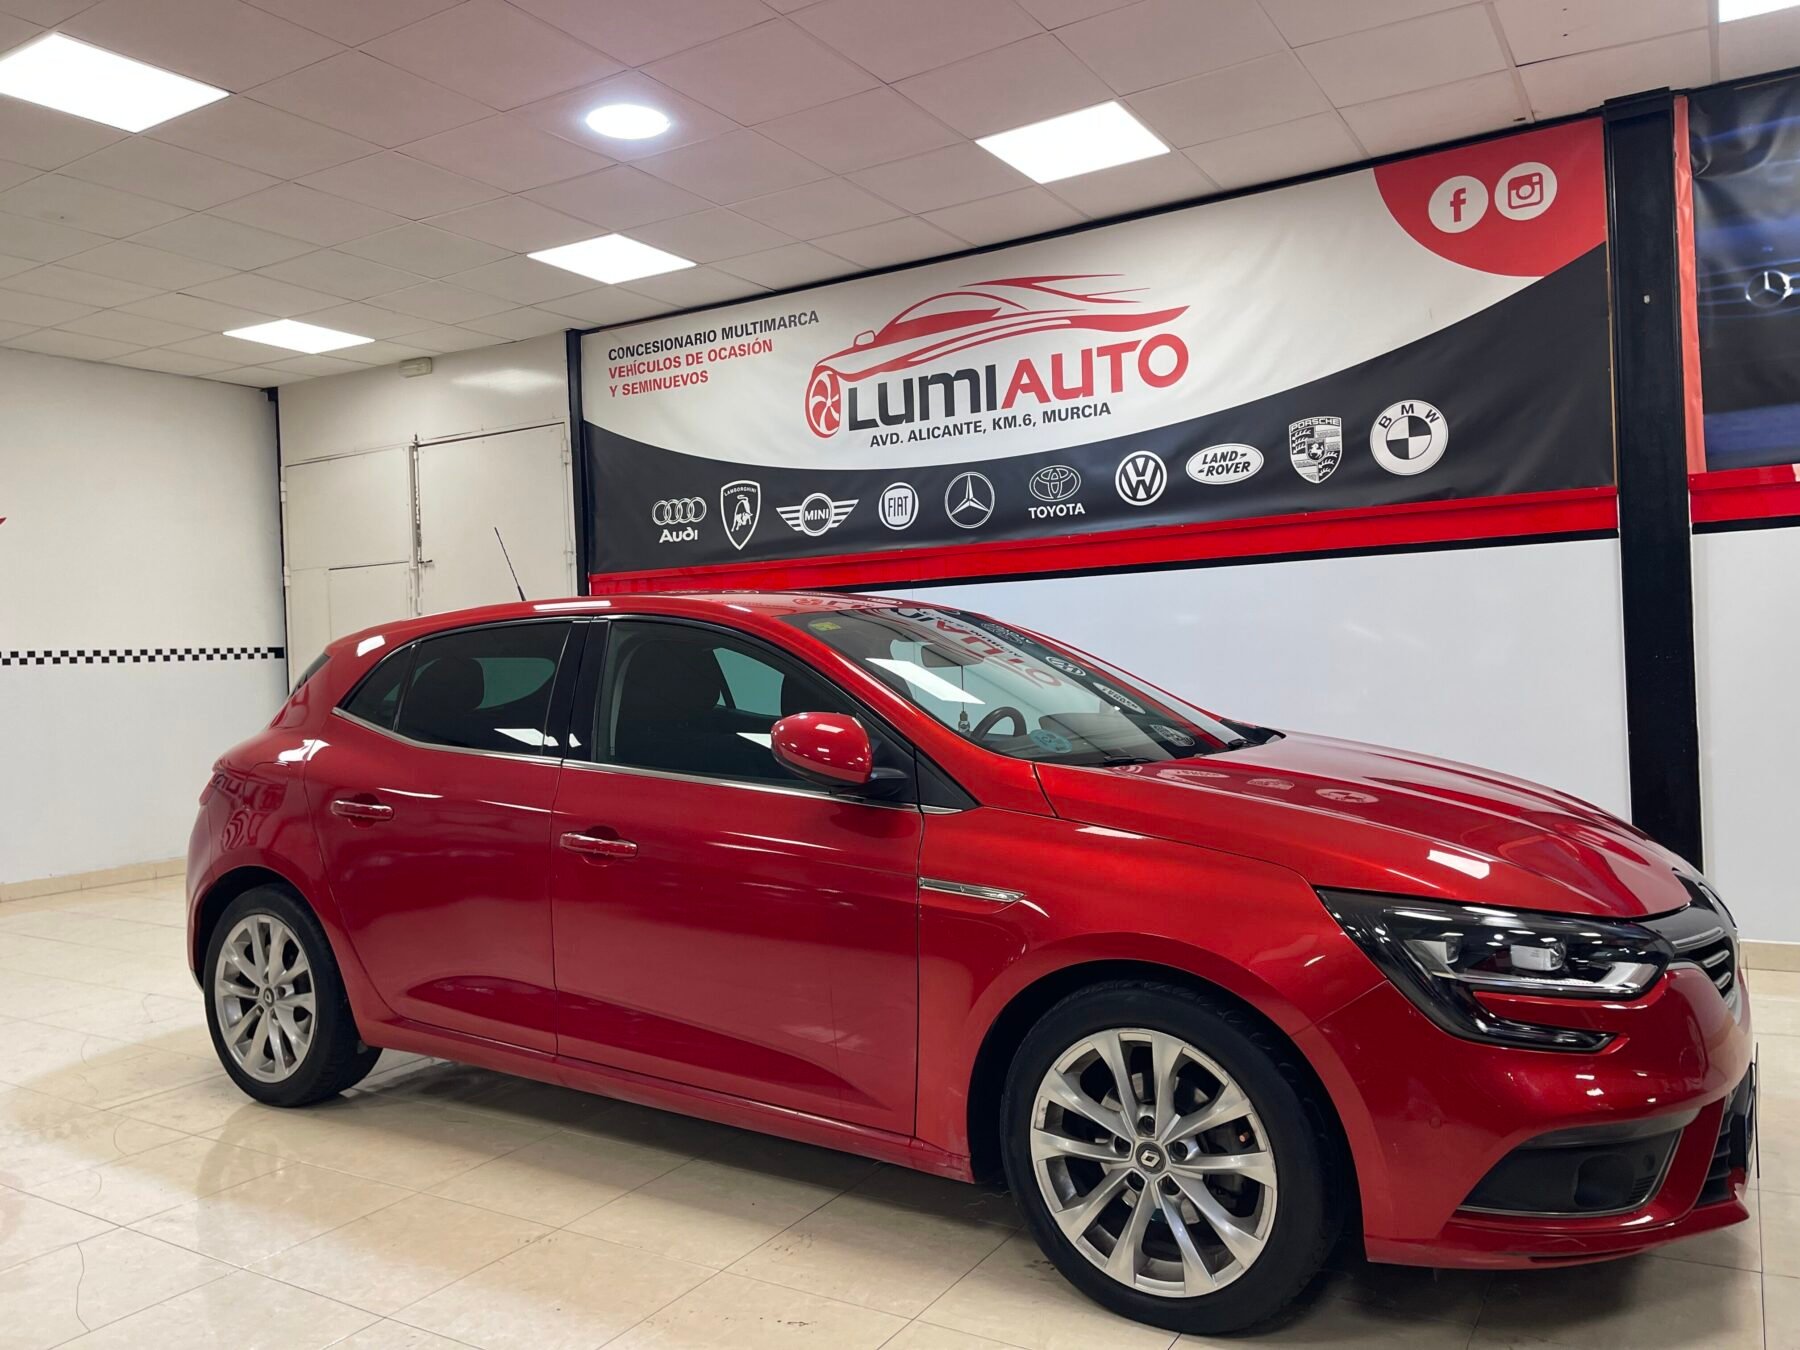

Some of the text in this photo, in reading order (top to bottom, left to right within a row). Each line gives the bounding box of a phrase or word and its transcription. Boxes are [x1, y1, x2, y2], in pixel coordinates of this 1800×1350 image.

[608, 310, 820, 361] CONCESIONARIO MULTIMARCA
[608, 338, 774, 379] VEHÍCULOS DE OCASIÓN
[609, 370, 709, 397] Y SEMINUEVOS
[1378, 403, 1440, 429] BMW
[869, 402, 1112, 448] AVD. ALICANTE, KM.6, MURCIA
[1291, 418, 1340, 432] PORSCHE
[1202, 450, 1239, 465] LAND
[1205, 461, 1251, 477] ROVER
[724, 486, 757, 497] LAMBORGHINI
[804, 508, 830, 521] MINI
[888, 495, 909, 518] FIAT
[1028, 502, 1086, 519] TOYOTA
[659, 526, 699, 543] Audi
